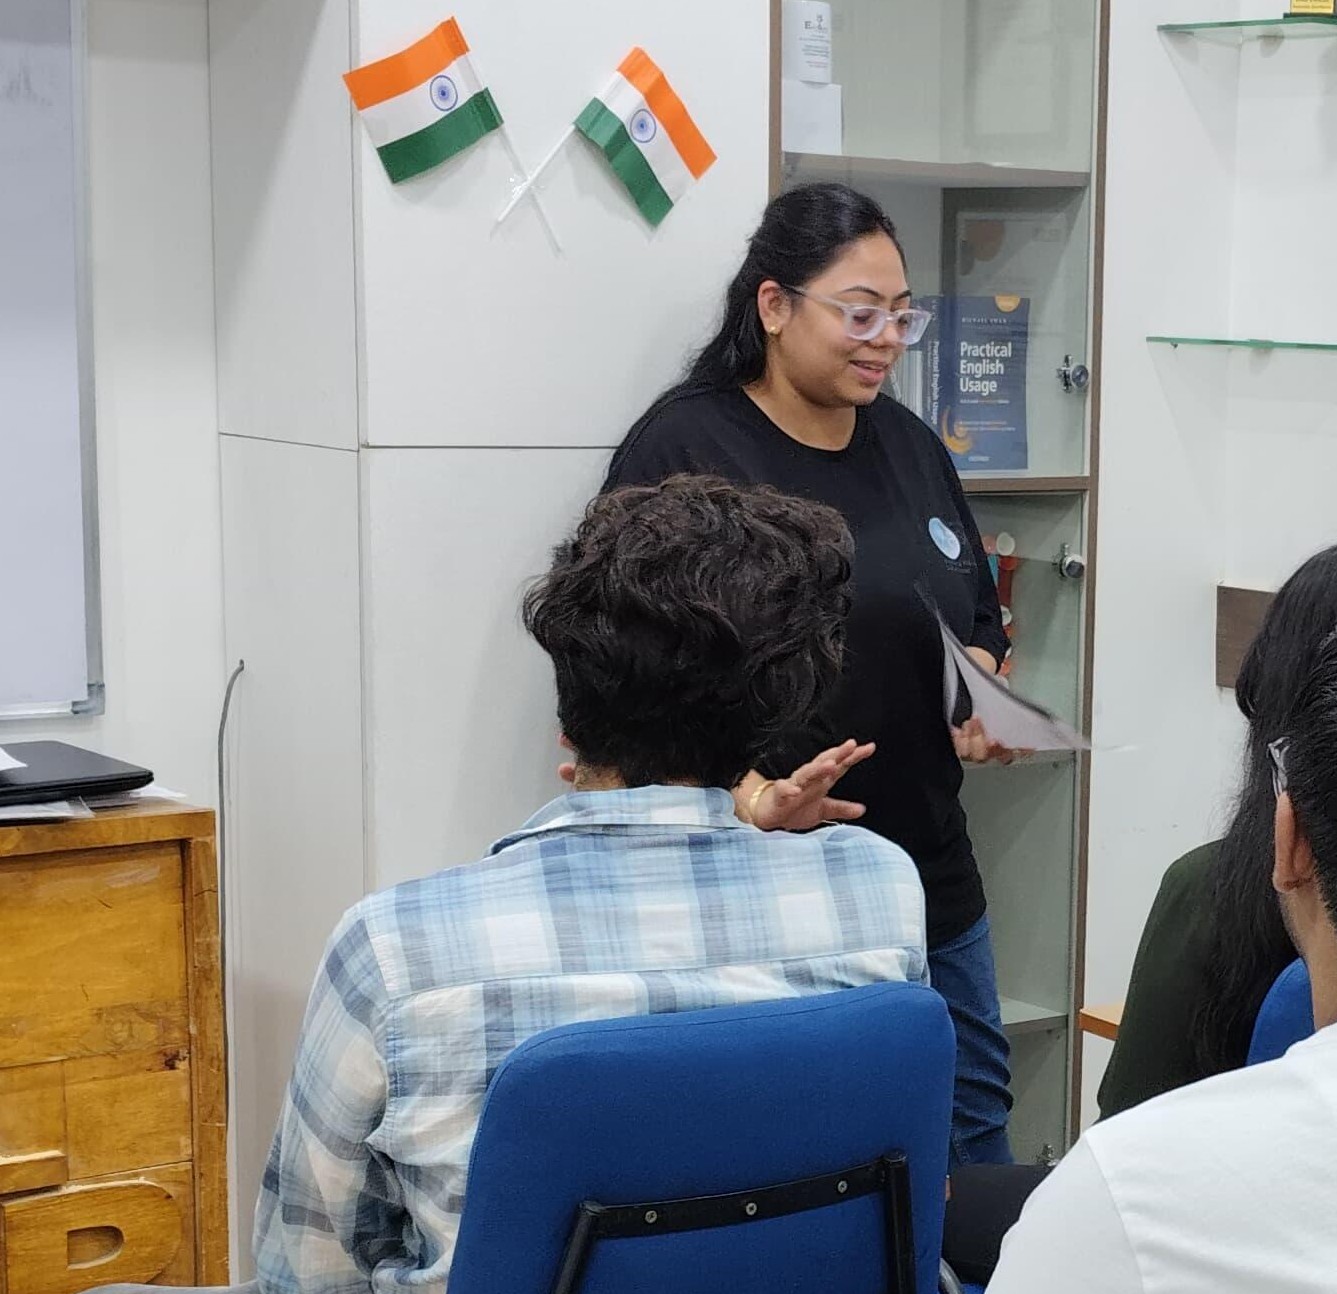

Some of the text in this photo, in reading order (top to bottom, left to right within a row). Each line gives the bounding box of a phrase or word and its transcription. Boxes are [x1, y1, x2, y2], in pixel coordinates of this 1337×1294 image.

[960, 341, 1012, 357] Practical
[960, 359, 1004, 378] English
[960, 377, 997, 396] Usage
